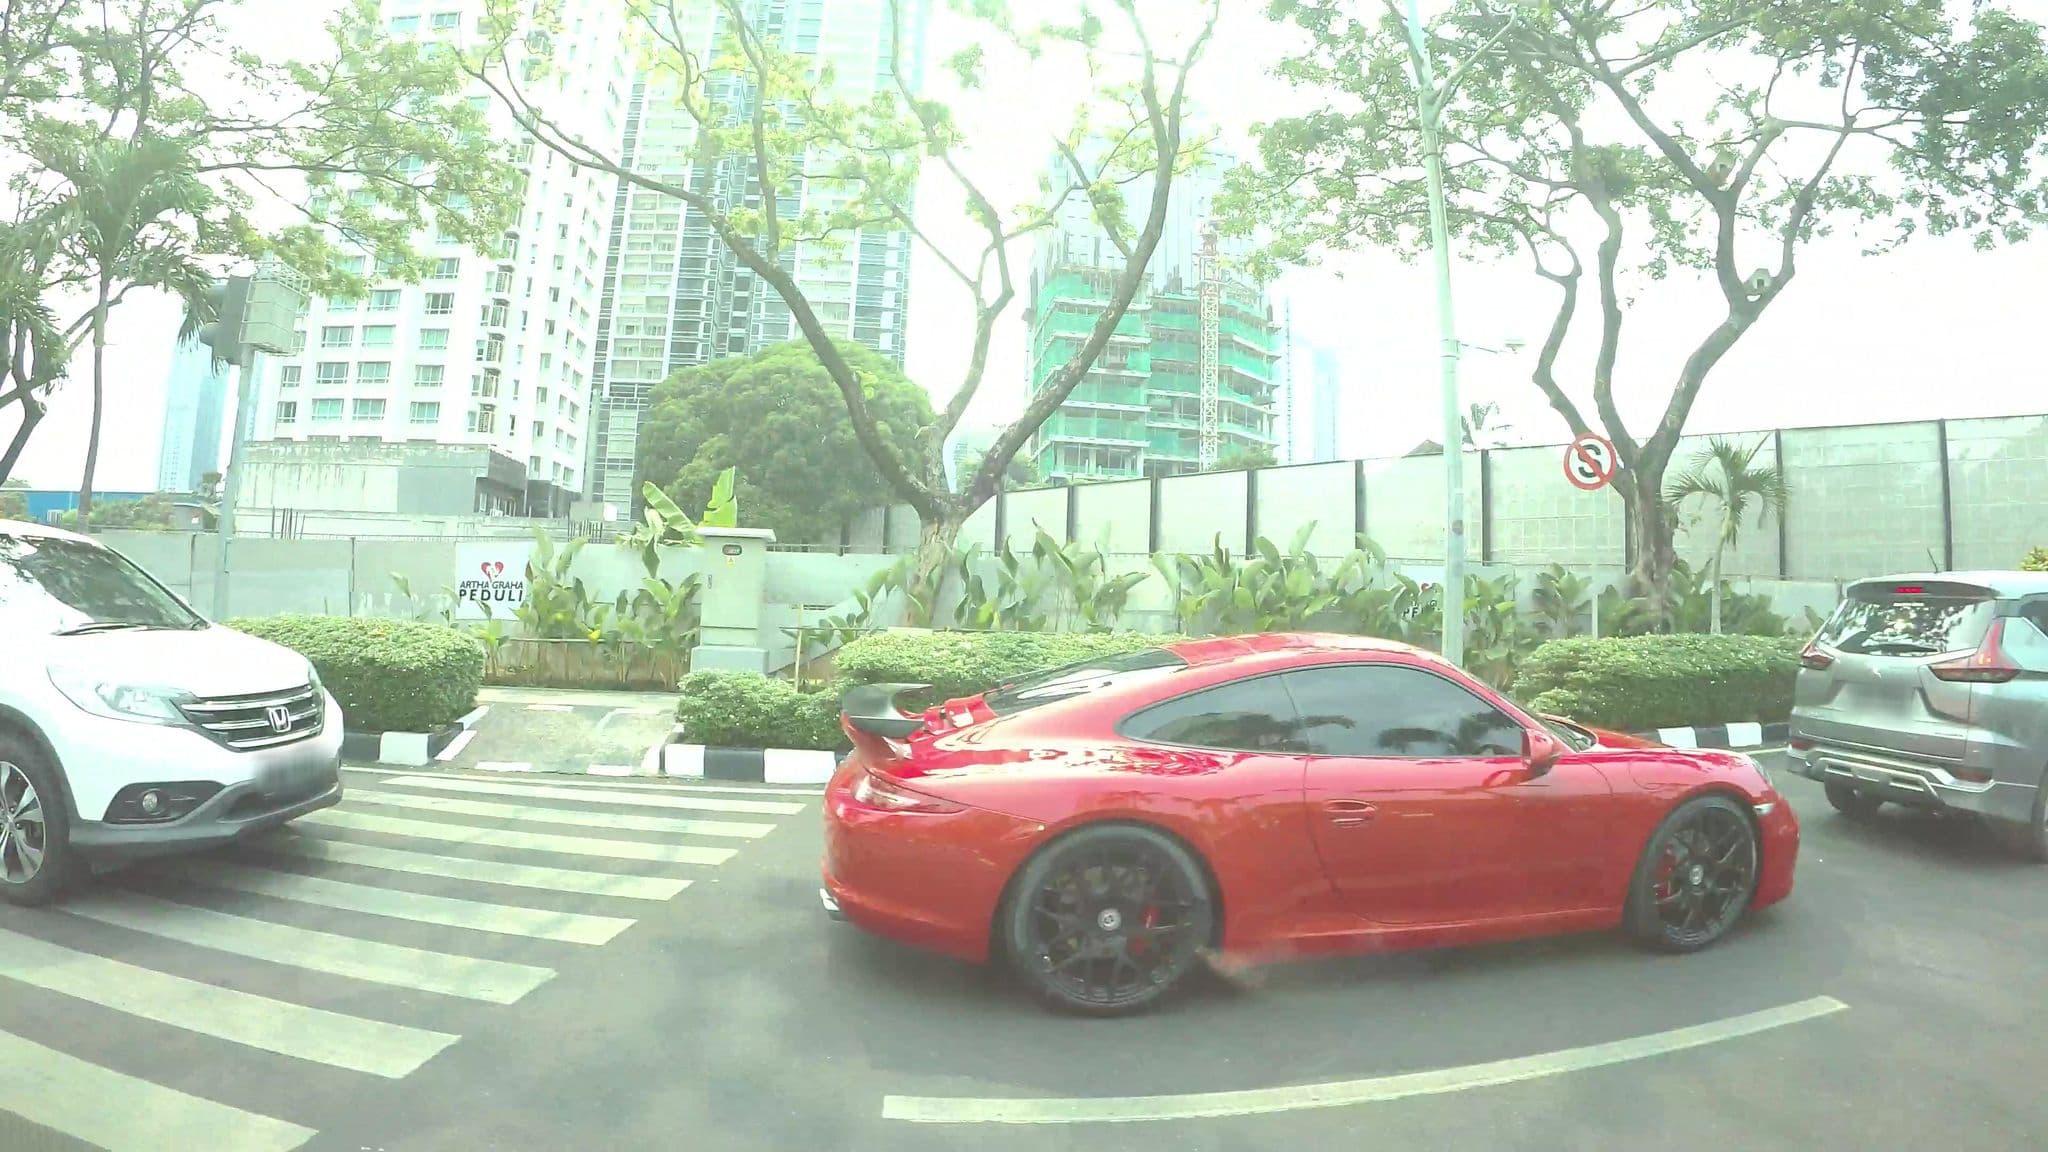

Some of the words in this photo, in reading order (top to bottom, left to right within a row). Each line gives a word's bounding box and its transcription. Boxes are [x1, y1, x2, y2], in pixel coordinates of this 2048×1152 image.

[1578, 444, 1603, 478] S
[460, 581, 489, 589] ARTHA
[492, 581, 523, 589] GRAHA
[459, 589, 523, 602] PEDULI
